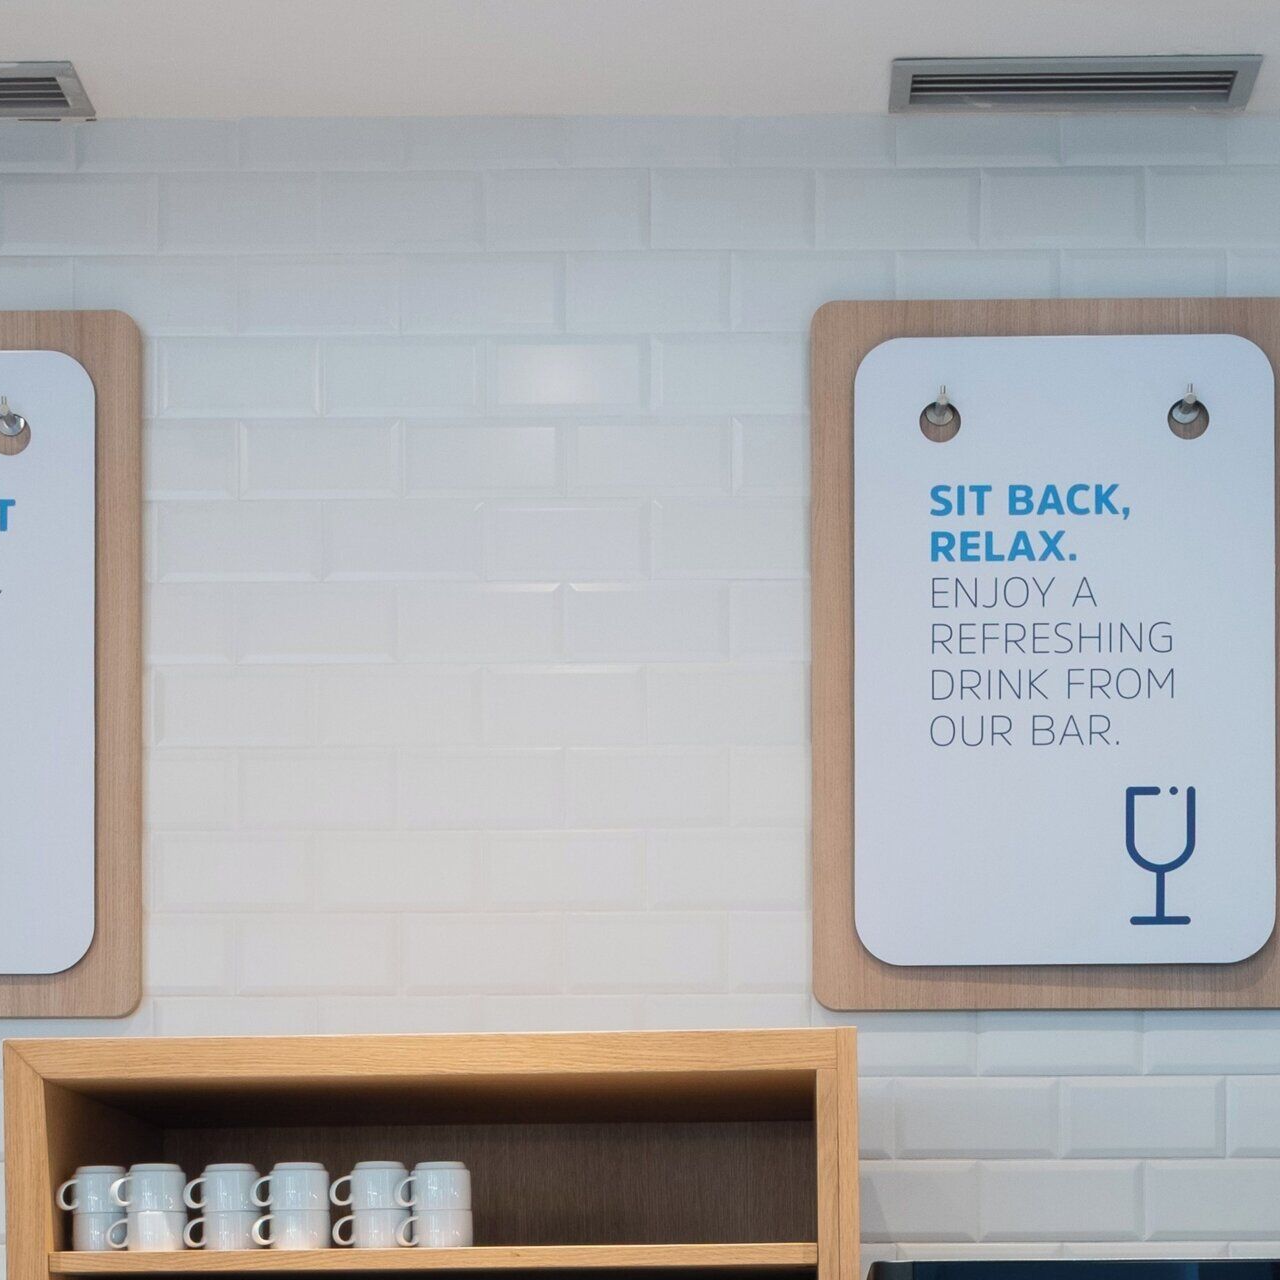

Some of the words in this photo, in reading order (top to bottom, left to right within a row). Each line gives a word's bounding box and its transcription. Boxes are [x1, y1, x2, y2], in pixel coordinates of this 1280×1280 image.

[930, 485, 992, 516] SIT
[1009, 484, 1130, 520] BACK,
[931, 530, 1076, 562] RELAX.
[932, 577, 1055, 608] ENJOY
[1072, 577, 1097, 607] A
[932, 622, 1172, 654] REFRESHING
[932, 669, 1048, 700] DRINK
[1068, 668, 1174, 699] FROM
[930, 715, 1012, 746] OUR
[1032, 715, 1119, 745] BAR.
